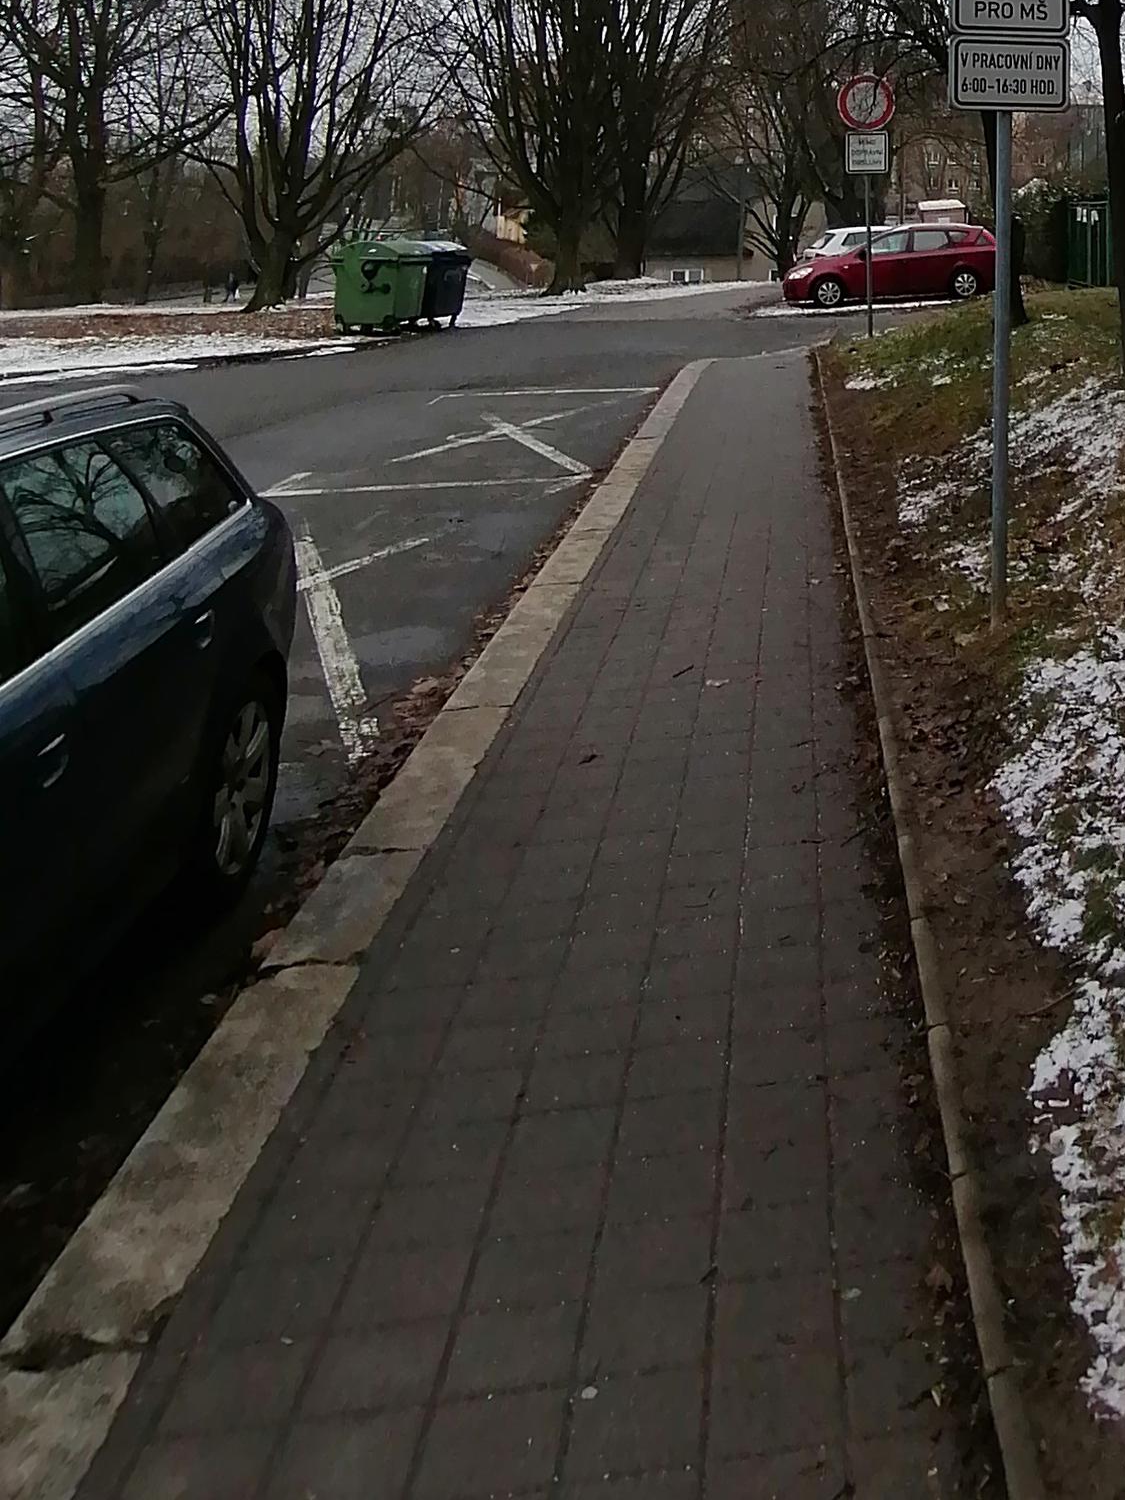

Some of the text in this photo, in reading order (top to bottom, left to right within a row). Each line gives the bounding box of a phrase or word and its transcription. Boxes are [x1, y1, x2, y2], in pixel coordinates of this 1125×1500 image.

[974, 0, 1048, 20] PRO MŠ
[960, 51, 1061, 71] V PRACOVNÍ DNY
[1030, 79, 1058, 95] HOD.
